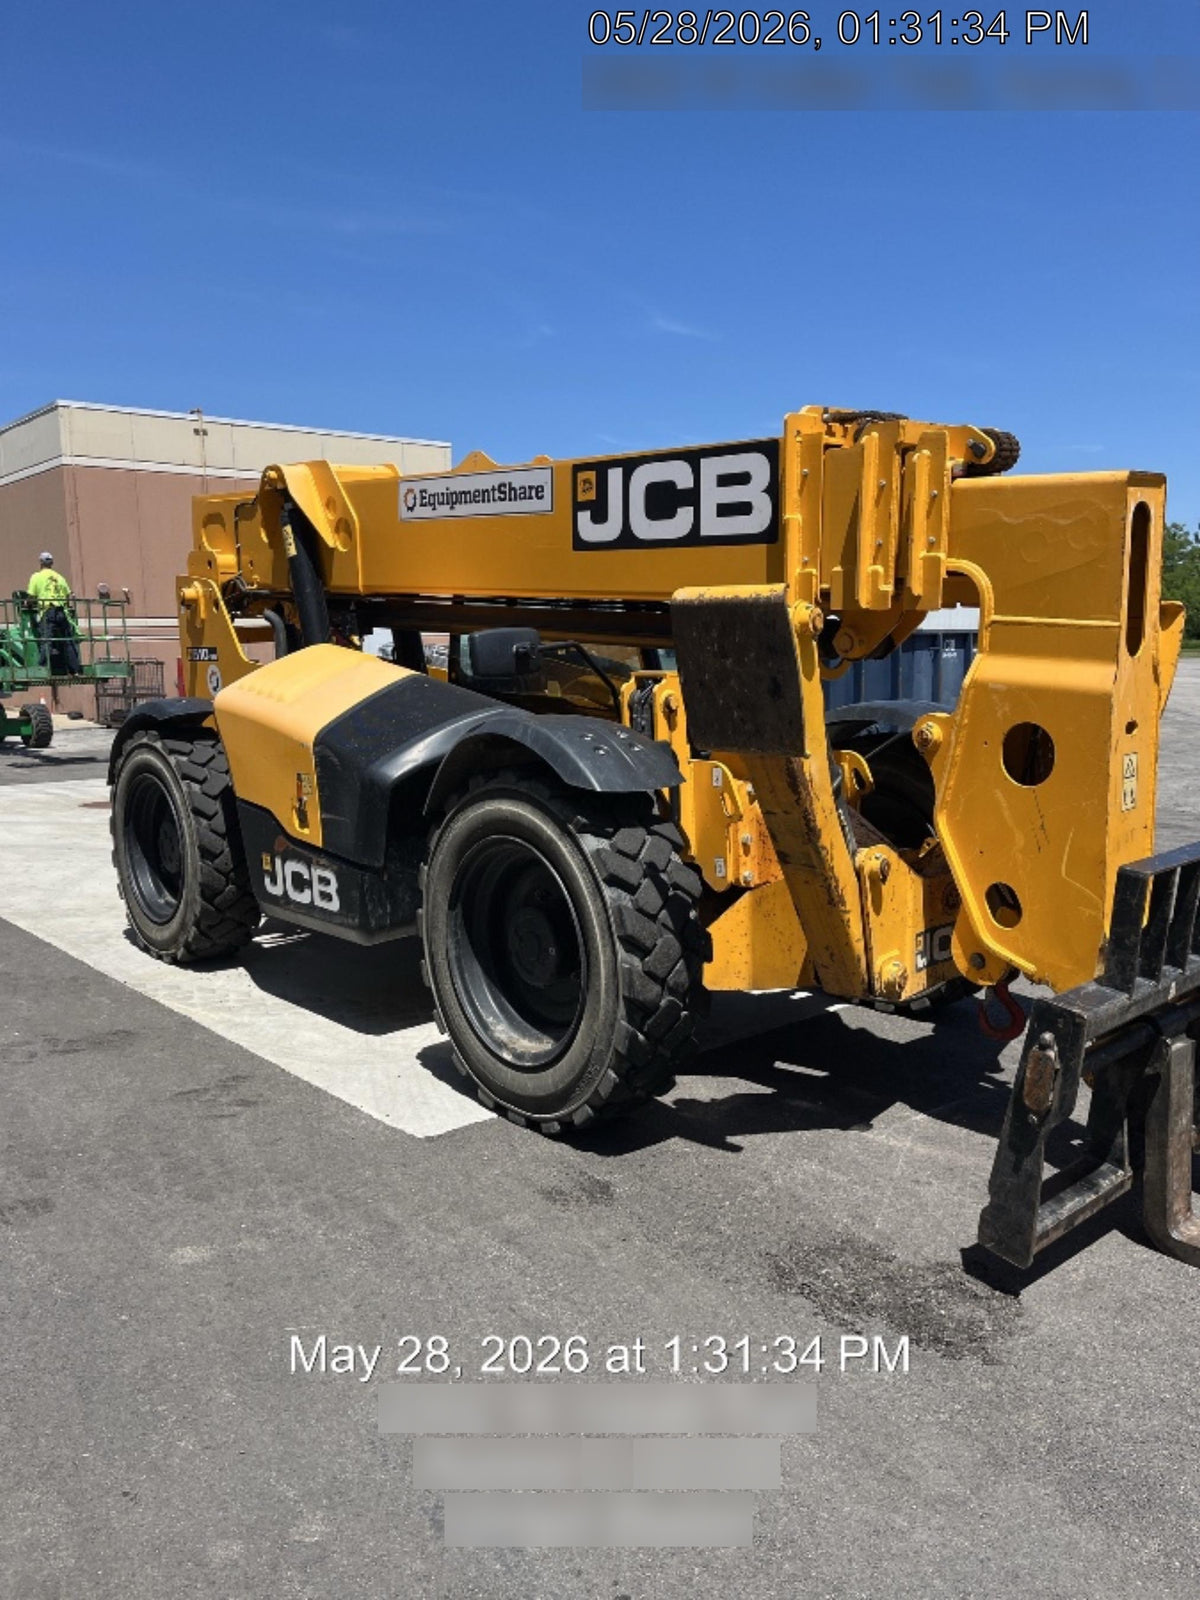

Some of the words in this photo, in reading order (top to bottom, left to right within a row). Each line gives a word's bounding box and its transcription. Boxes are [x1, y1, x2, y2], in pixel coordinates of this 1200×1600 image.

[419, 481, 545, 511] EquipmentShare
[577, 452, 773, 542] JCB
[264, 855, 341, 912] JCB
[916, 926, 954, 968] JC
